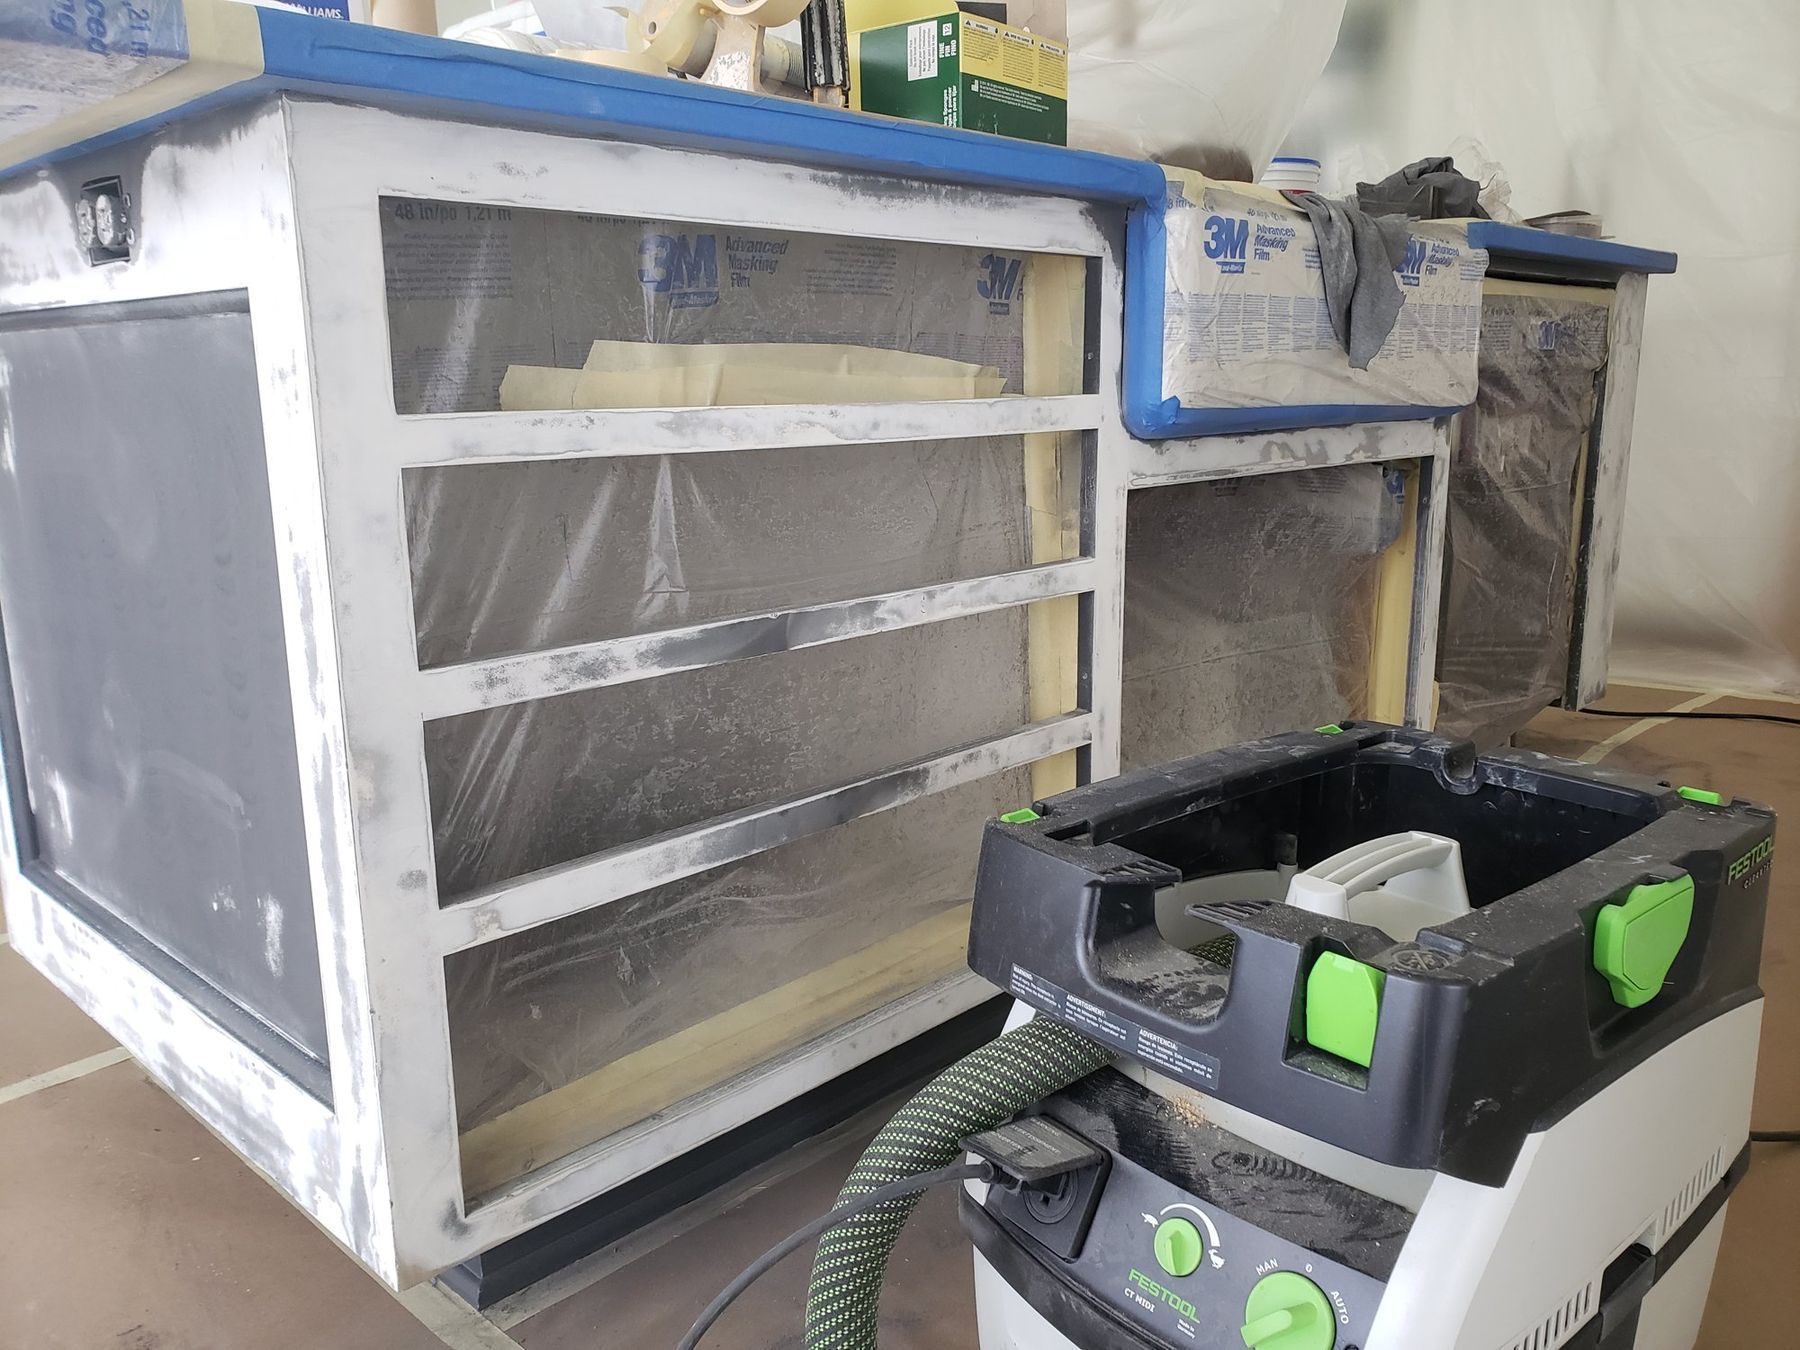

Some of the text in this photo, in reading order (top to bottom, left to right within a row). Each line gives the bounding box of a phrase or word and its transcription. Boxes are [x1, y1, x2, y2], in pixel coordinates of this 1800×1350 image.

[395, 203, 415, 220] 48
[498, 207, 511, 220] m
[1203, 215, 1249, 260] 3M
[1256, 224, 1296, 238] Advanced
[726, 236, 789, 255] Advanced
[1253, 235, 1289, 252] Masking
[1431, 243, 1460, 257] Advanced
[638, 234, 718, 292] 3M
[729, 254, 779, 274] Masking
[1253, 248, 1271, 262] Film
[731, 272, 750, 288] Film
[977, 254, 1022, 300] 3M
[1728, 834, 1775, 886] FESTOOL
[1255, 1258, 1279, 1276] MAN
[1305, 1263, 1313, 1273] 0
[1124, 1287, 1156, 1313] CT MIDI
[1128, 1268, 1200, 1324] FESTOOL
[1330, 1290, 1350, 1325] AUTO
